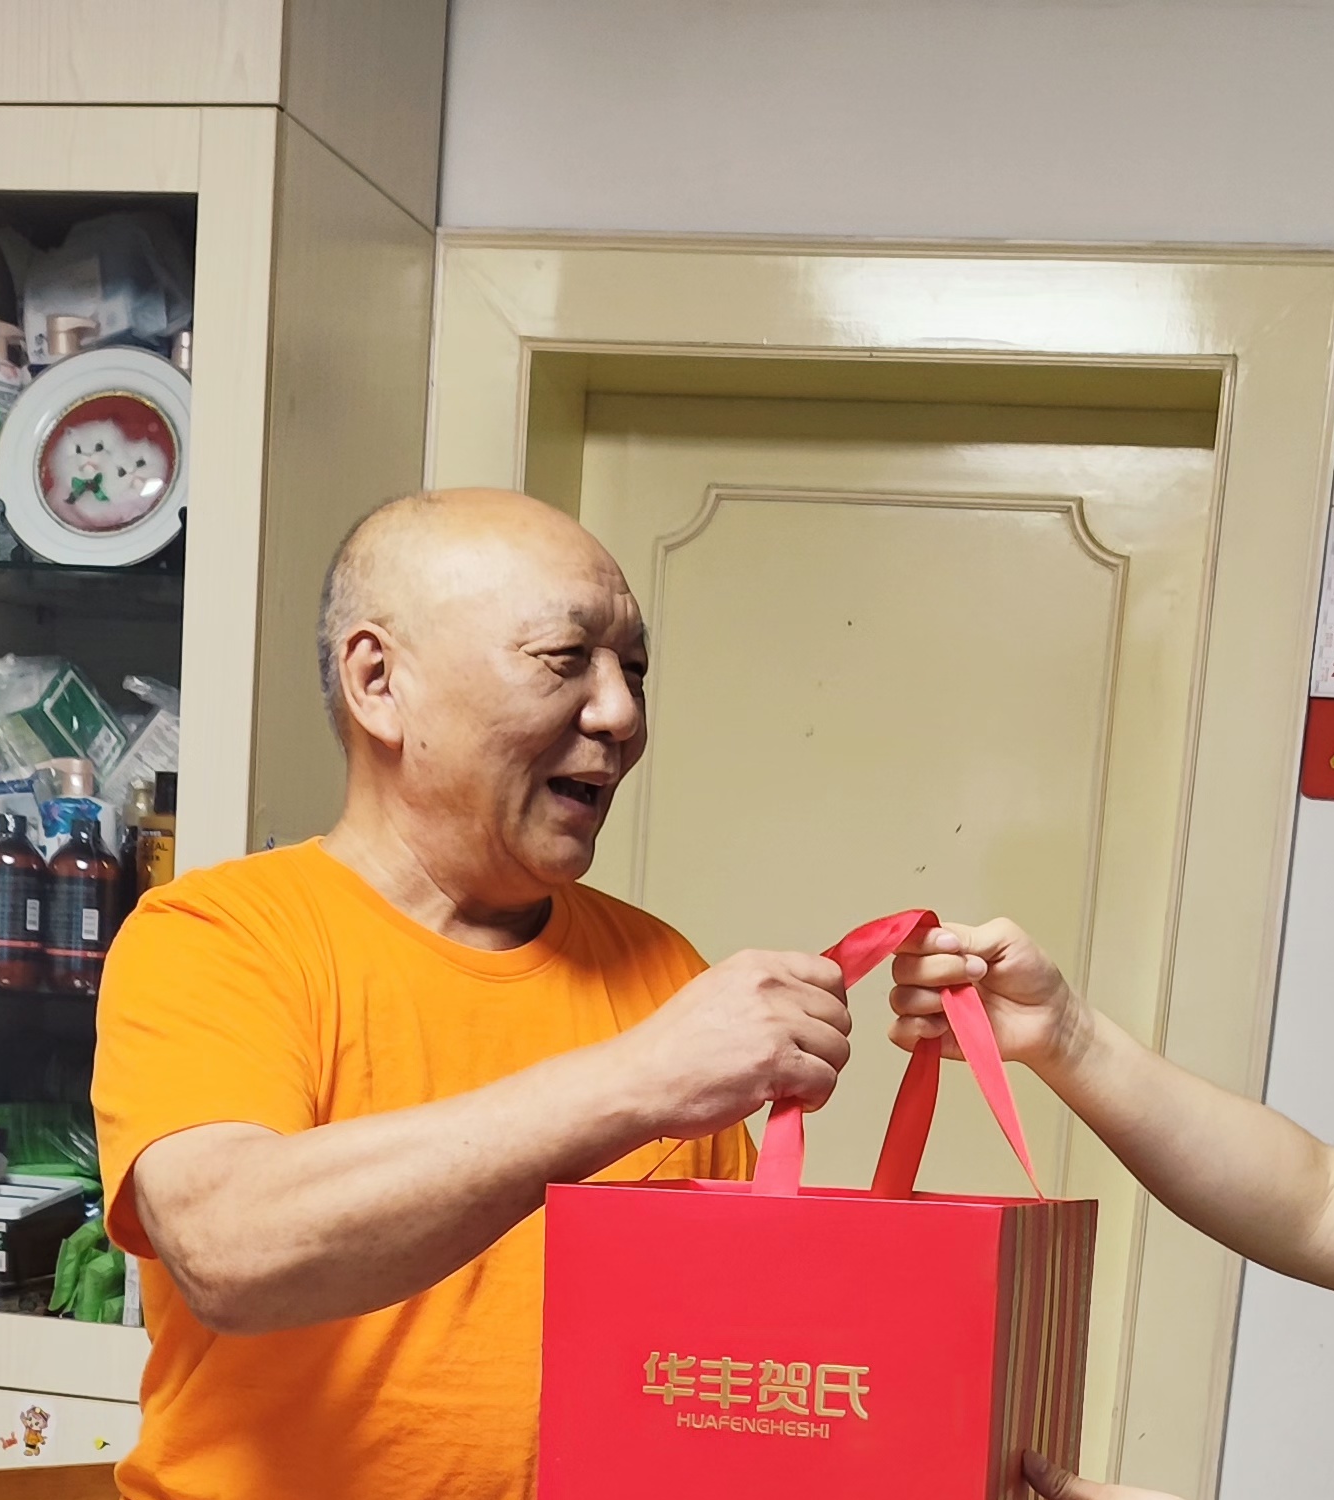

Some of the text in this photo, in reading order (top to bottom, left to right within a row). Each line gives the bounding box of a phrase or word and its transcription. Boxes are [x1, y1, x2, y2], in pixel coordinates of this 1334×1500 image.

[642, 1350, 870, 1421] 华丰贺氏
[677, 1412, 830, 1439] HUAFENGHESHI
